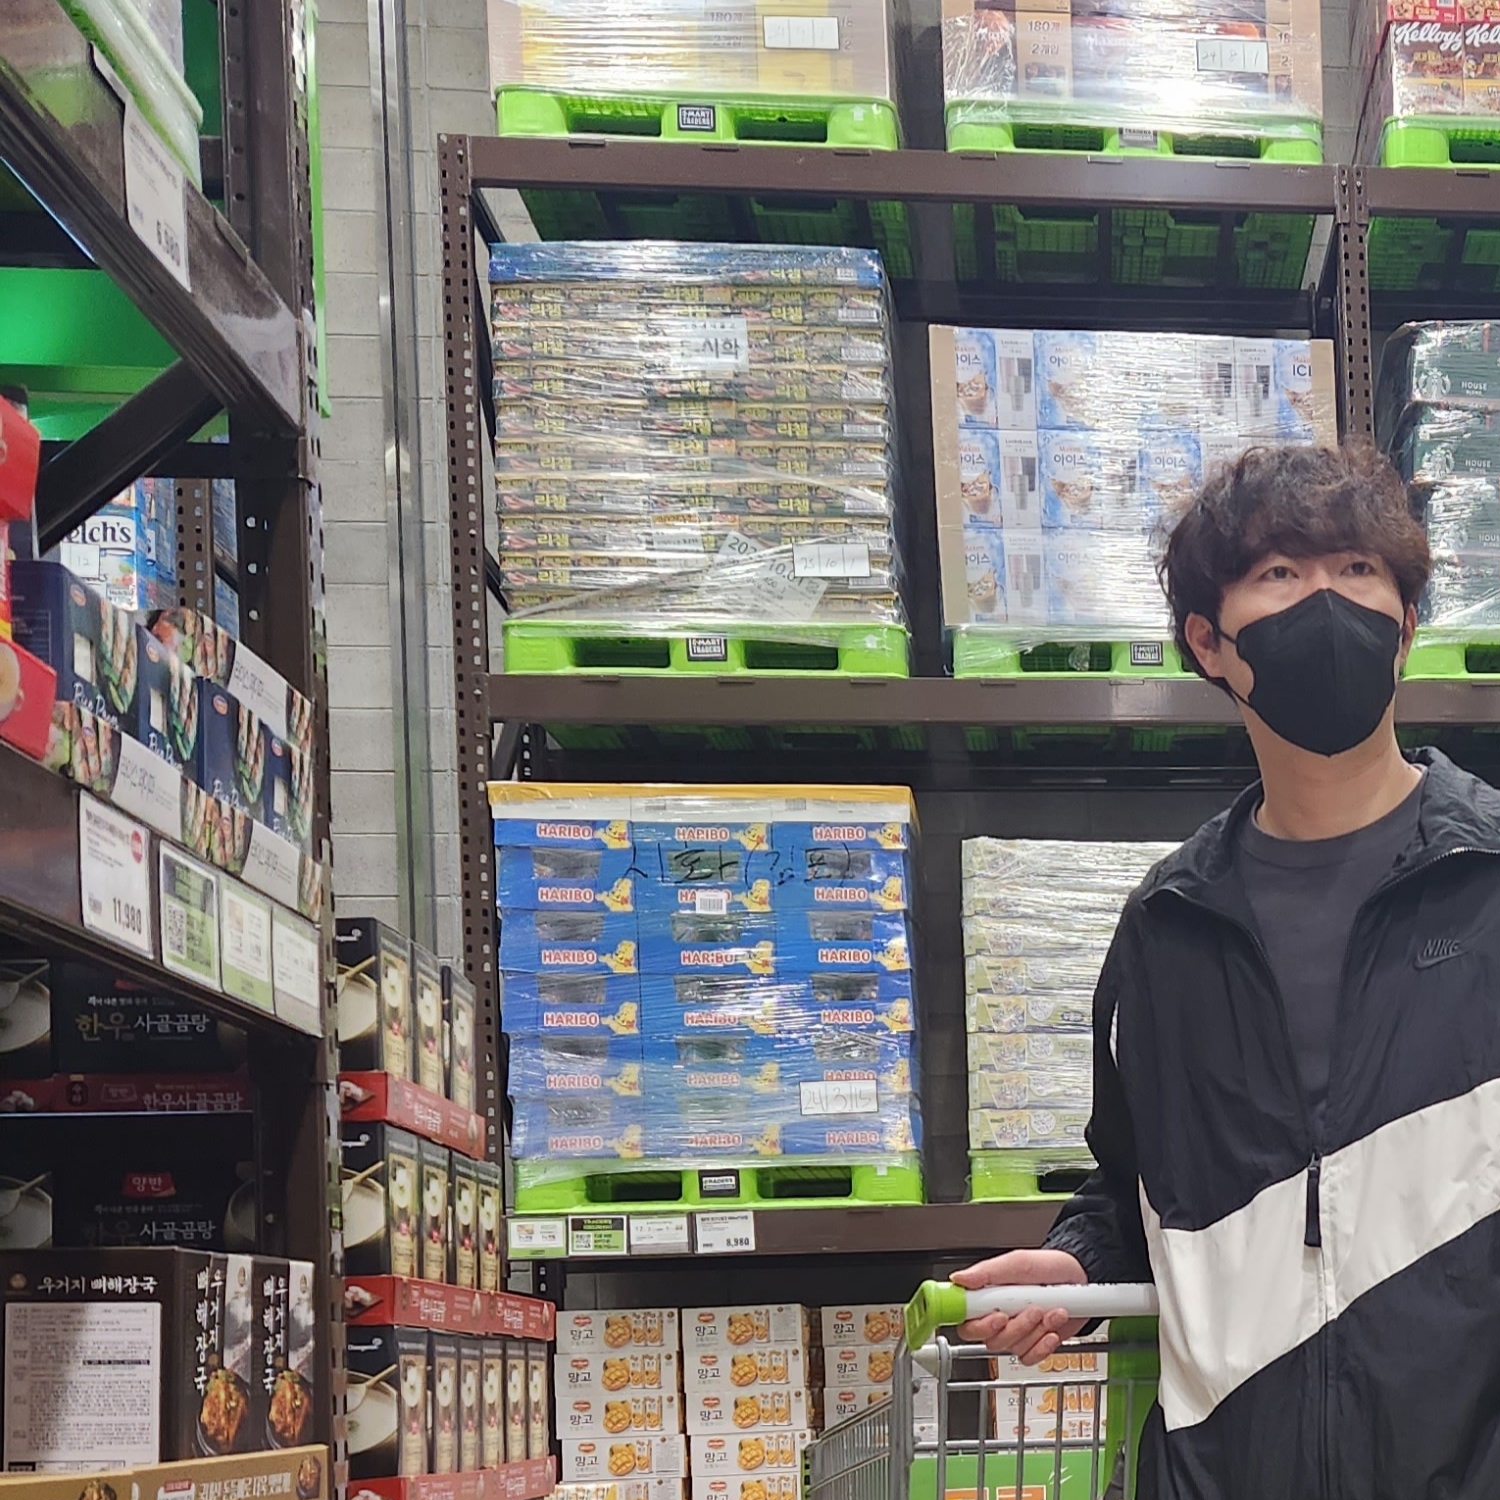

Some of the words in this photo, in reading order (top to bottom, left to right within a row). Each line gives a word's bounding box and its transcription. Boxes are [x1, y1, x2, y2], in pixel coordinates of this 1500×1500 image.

[1462, 381, 1487, 391] HOUSE
[1465, 460, 1491, 468] HOUSE
[64, 520, 131, 544] elch's
[536, 823, 593, 839] HARIBO
[675, 827, 730, 842] HARIBO
[813, 826, 866, 841] HARIBO
[539, 887, 594, 903] HARIBO
[814, 887, 869, 903] HARIBO
[1423, 938, 1461, 956] NIKE
[542, 949, 597, 965] HARIBO
[681, 951, 735, 965] HARIBO
[818, 949, 871, 964] HARIBO
[544, 1012, 600, 1027] HARIBO
[684, 1012, 738, 1026] HARIBO
[821, 1010, 874, 1024] HARIBO
[546, 1074, 601, 1089] HARIBO
[687, 1072, 740, 1086] HARIBO
[548, 1136, 602, 1151] HARIBO
[726, 1238, 750, 1247] 8,980
[1008, 1397, 1033, 1406] 오지
